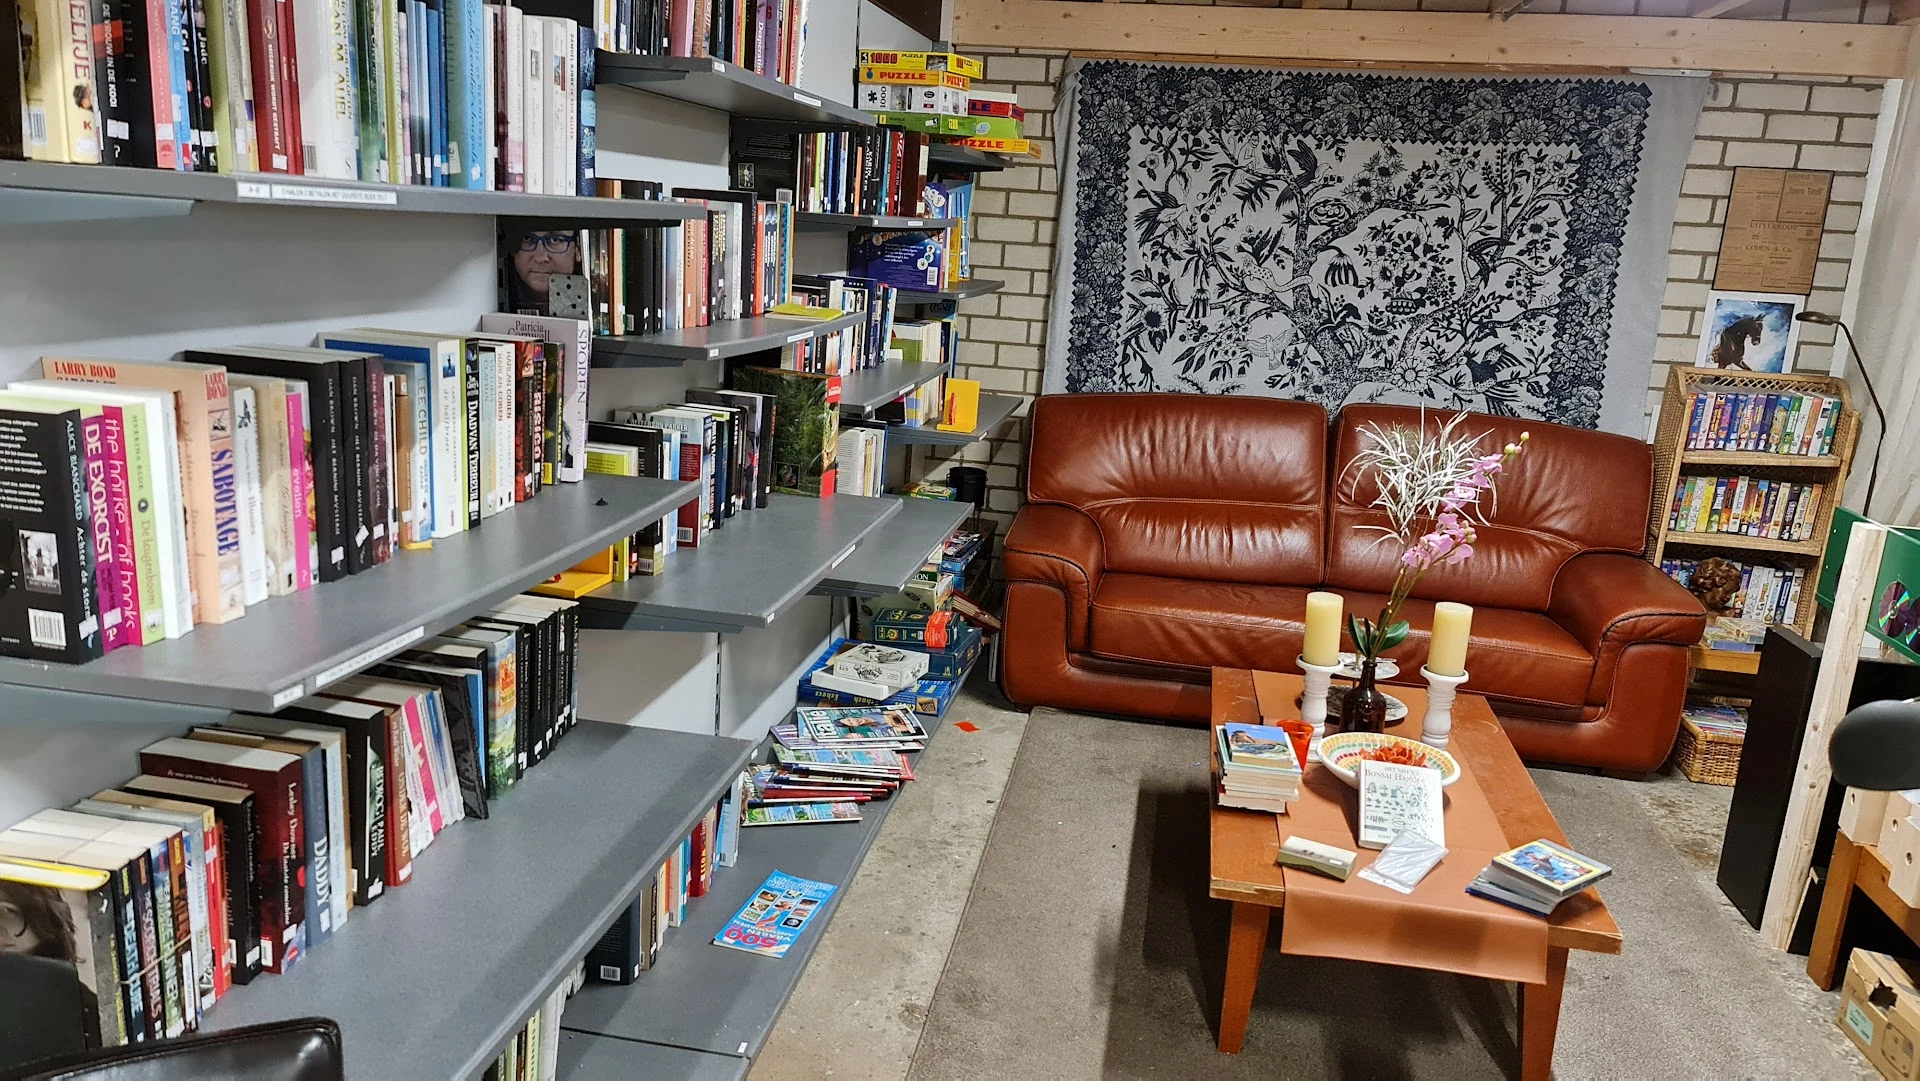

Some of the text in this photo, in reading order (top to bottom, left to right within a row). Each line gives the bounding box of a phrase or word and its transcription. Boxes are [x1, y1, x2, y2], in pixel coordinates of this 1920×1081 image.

[69, 0, 91, 80] ELTJE
[103, 18, 114, 55] VROUW
[198, 31, 208, 65] Jade
[106, 56, 115, 67] IN
[107, 68, 116, 82] DE
[267, 43, 275, 82] MISBRUIK
[870, 52, 898, 64] 1000
[879, 71, 927, 80] PUZZLE
[946, 74, 967, 88] PUZZLE
[109, 83, 118, 108] KOOI
[880, 86, 888, 108] 1000
[83, 120, 92, 131] K
[863, 135, 871, 192] SLAUGHTER
[1750, 222, 1798, 231] UITVERKOOP
[514, 320, 544, 333] Patricia
[54, 360, 116, 380] LARRY BOND
[205, 371, 227, 387] LARRY
[505, 351, 513, 388] HARLAN
[577, 328, 588, 404] SPOREN
[206, 383, 228, 401] BOND
[497, 352, 505, 422] HARLAN COBEN
[505, 388, 513, 419] COBEN
[416, 377, 428, 456] LEE CHILD
[665, 422, 688, 433] PARKER
[66, 418, 77, 453] ALICE
[104, 417, 121, 453] the
[467, 399, 480, 502] DAAD VAN TERREUR
[69, 454, 83, 521] BLANCHARD
[84, 423, 113, 564] DE EXORCIST
[211, 448, 240, 557] SABOTAGE
[292, 467, 303, 518] evelien
[76, 526, 86, 566] Achter
[117, 542, 134, 568] of
[140, 519, 158, 606] De leugenboom
[80, 569, 89, 585] de
[119, 569, 137, 630] books
[815, 690, 839, 701] Echecs
[806, 710, 838, 739] Italië
[1365, 769, 1392, 780] BONSAI
[287, 782, 298, 816] Lesley
[398, 770, 406, 814] ONDER
[376, 820, 384, 852] PAUL
[399, 815, 407, 831] DE
[313, 835, 330, 908] DADDY
[123, 921, 140, 974] DEATH
[724, 928, 779, 949] 500
[746, 929, 791, 942] VRAGEN
[162, 942, 179, 1006] RUNNER
[129, 975, 143, 1019] CURE
[147, 970, 163, 1019] TRIALS
